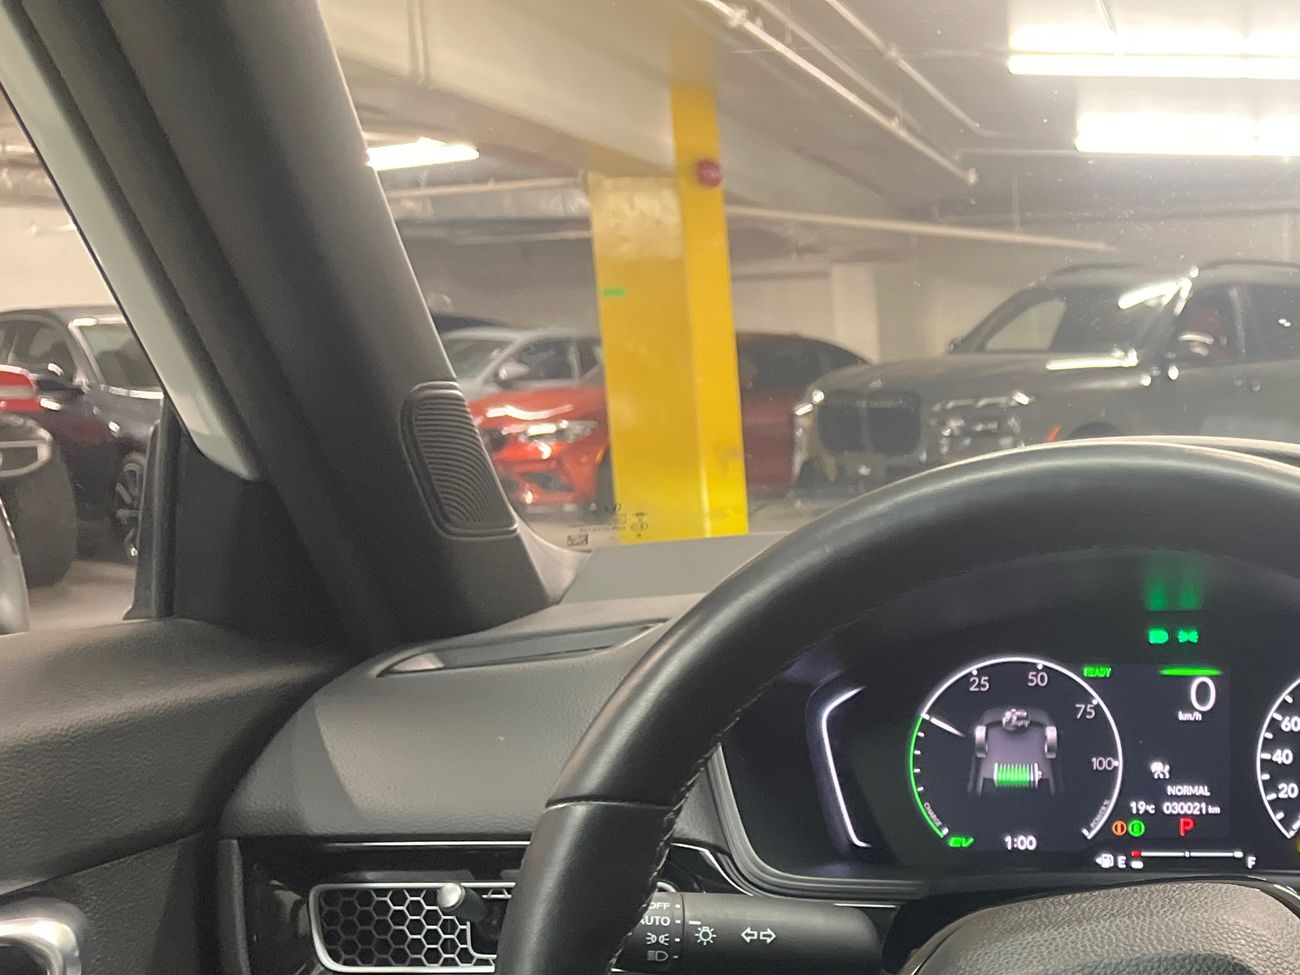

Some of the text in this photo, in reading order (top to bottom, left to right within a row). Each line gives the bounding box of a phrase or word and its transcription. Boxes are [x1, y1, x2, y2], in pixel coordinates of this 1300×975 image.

[1083, 665, 1112, 678] READY
[969, 677, 990, 693] 25
[1027, 671, 1048, 688] 50
[1190, 676, 1216, 712] 0
[1075, 704, 1096, 720] 75
[1178, 711, 1202, 722] km/h
[1091, 756, 1115, 772] 100
[1271, 750, 1294, 766] 40
[1166, 784, 1211, 796] NORMAL
[1277, 784, 1299, 800] 20
[1162, 801, 1206, 815] 030021
[1179, 817, 1195, 837] P
[1004, 835, 1037, 850] 1:00
[1117, 855, 1127, 869] E
[1247, 856, 1257, 869] F
[649, 901, 671, 911] OFF
